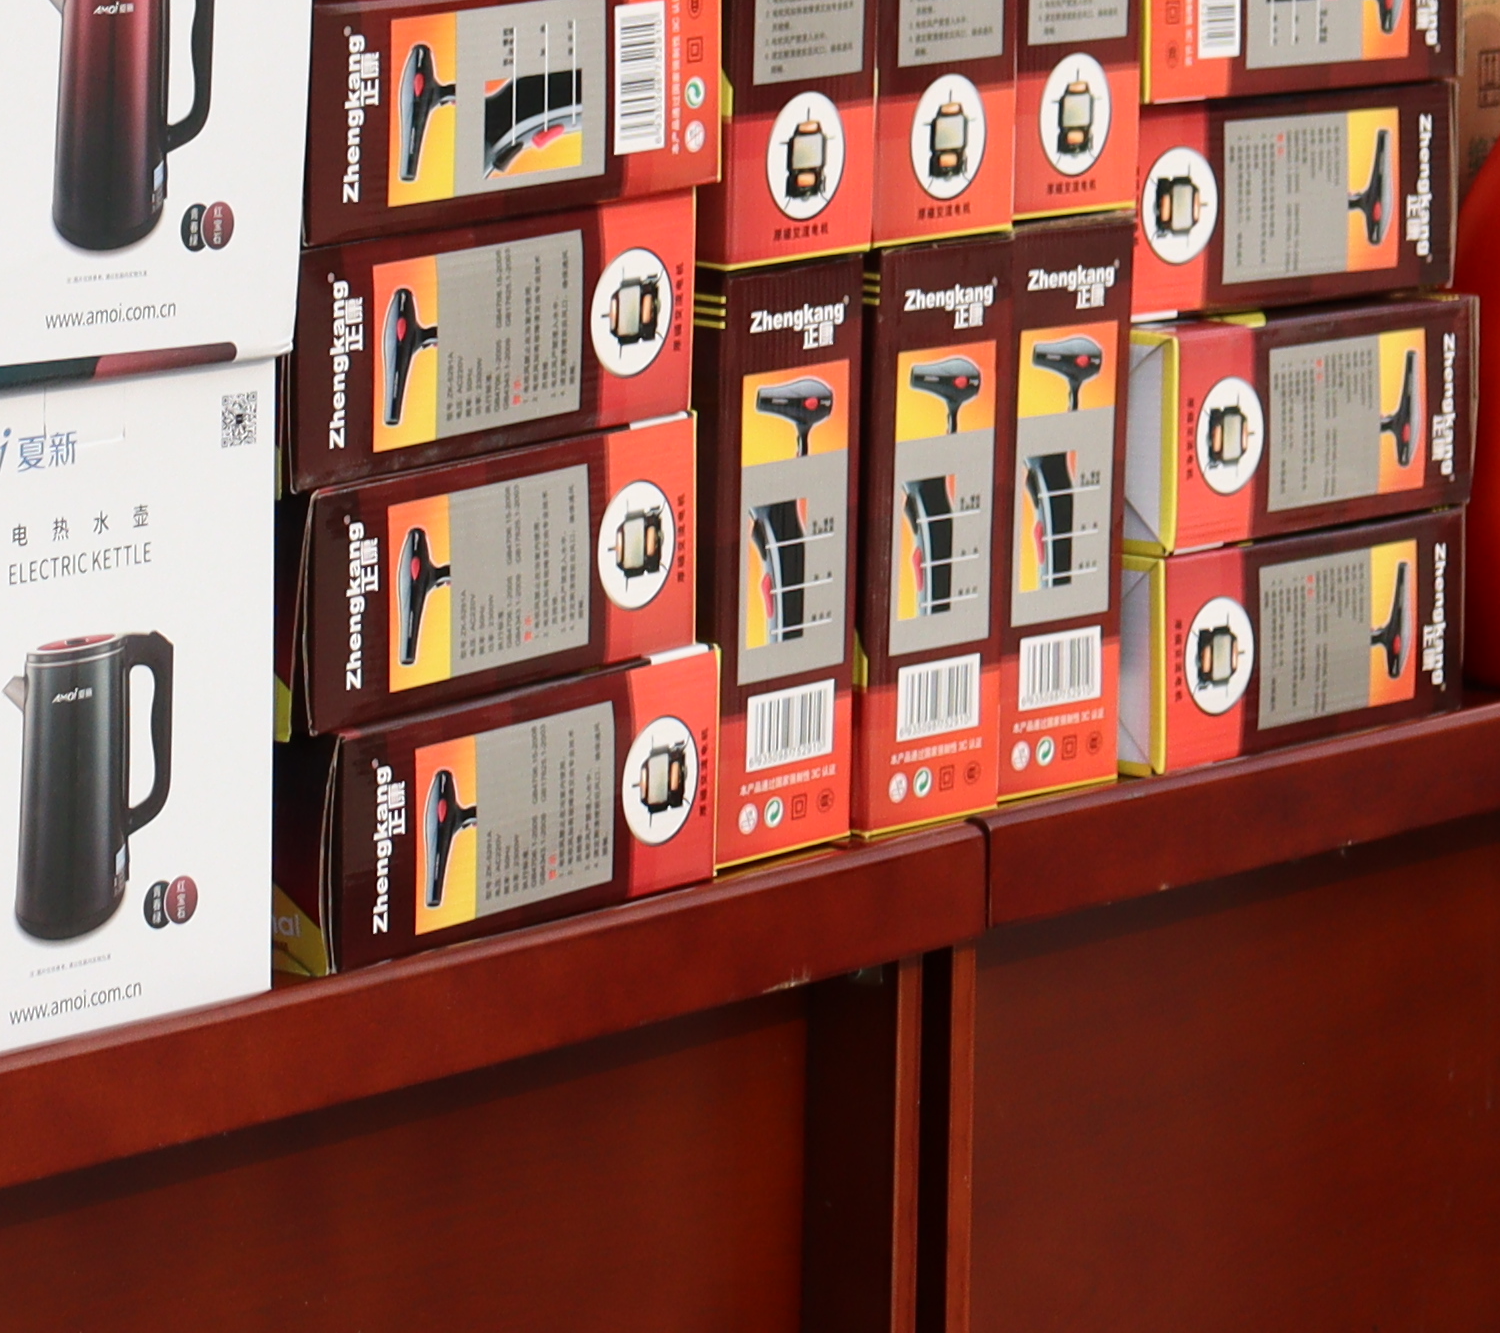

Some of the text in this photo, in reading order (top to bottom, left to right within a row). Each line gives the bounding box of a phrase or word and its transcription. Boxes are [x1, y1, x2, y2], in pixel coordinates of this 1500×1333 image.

[342, 34, 366, 203] Zhengkang
[904, 284, 994, 312] Zhengkang
[1027, 264, 1115, 292] Zhengkang
[45, 301, 177, 330] www.amoi.com.cn
[750, 301, 845, 333] Zhengkang
[328, 281, 350, 449] Zhengkang
[17, 431, 77, 471] 夏新
[11, 503, 150, 547] 电热水壶
[8, 542, 152, 585] ELECTRIC KETTLE
[345, 521, 365, 691] Zhengkang
[372, 764, 393, 934] Zhengkang
[9, 981, 142, 1026] www.amoi.com.cn
